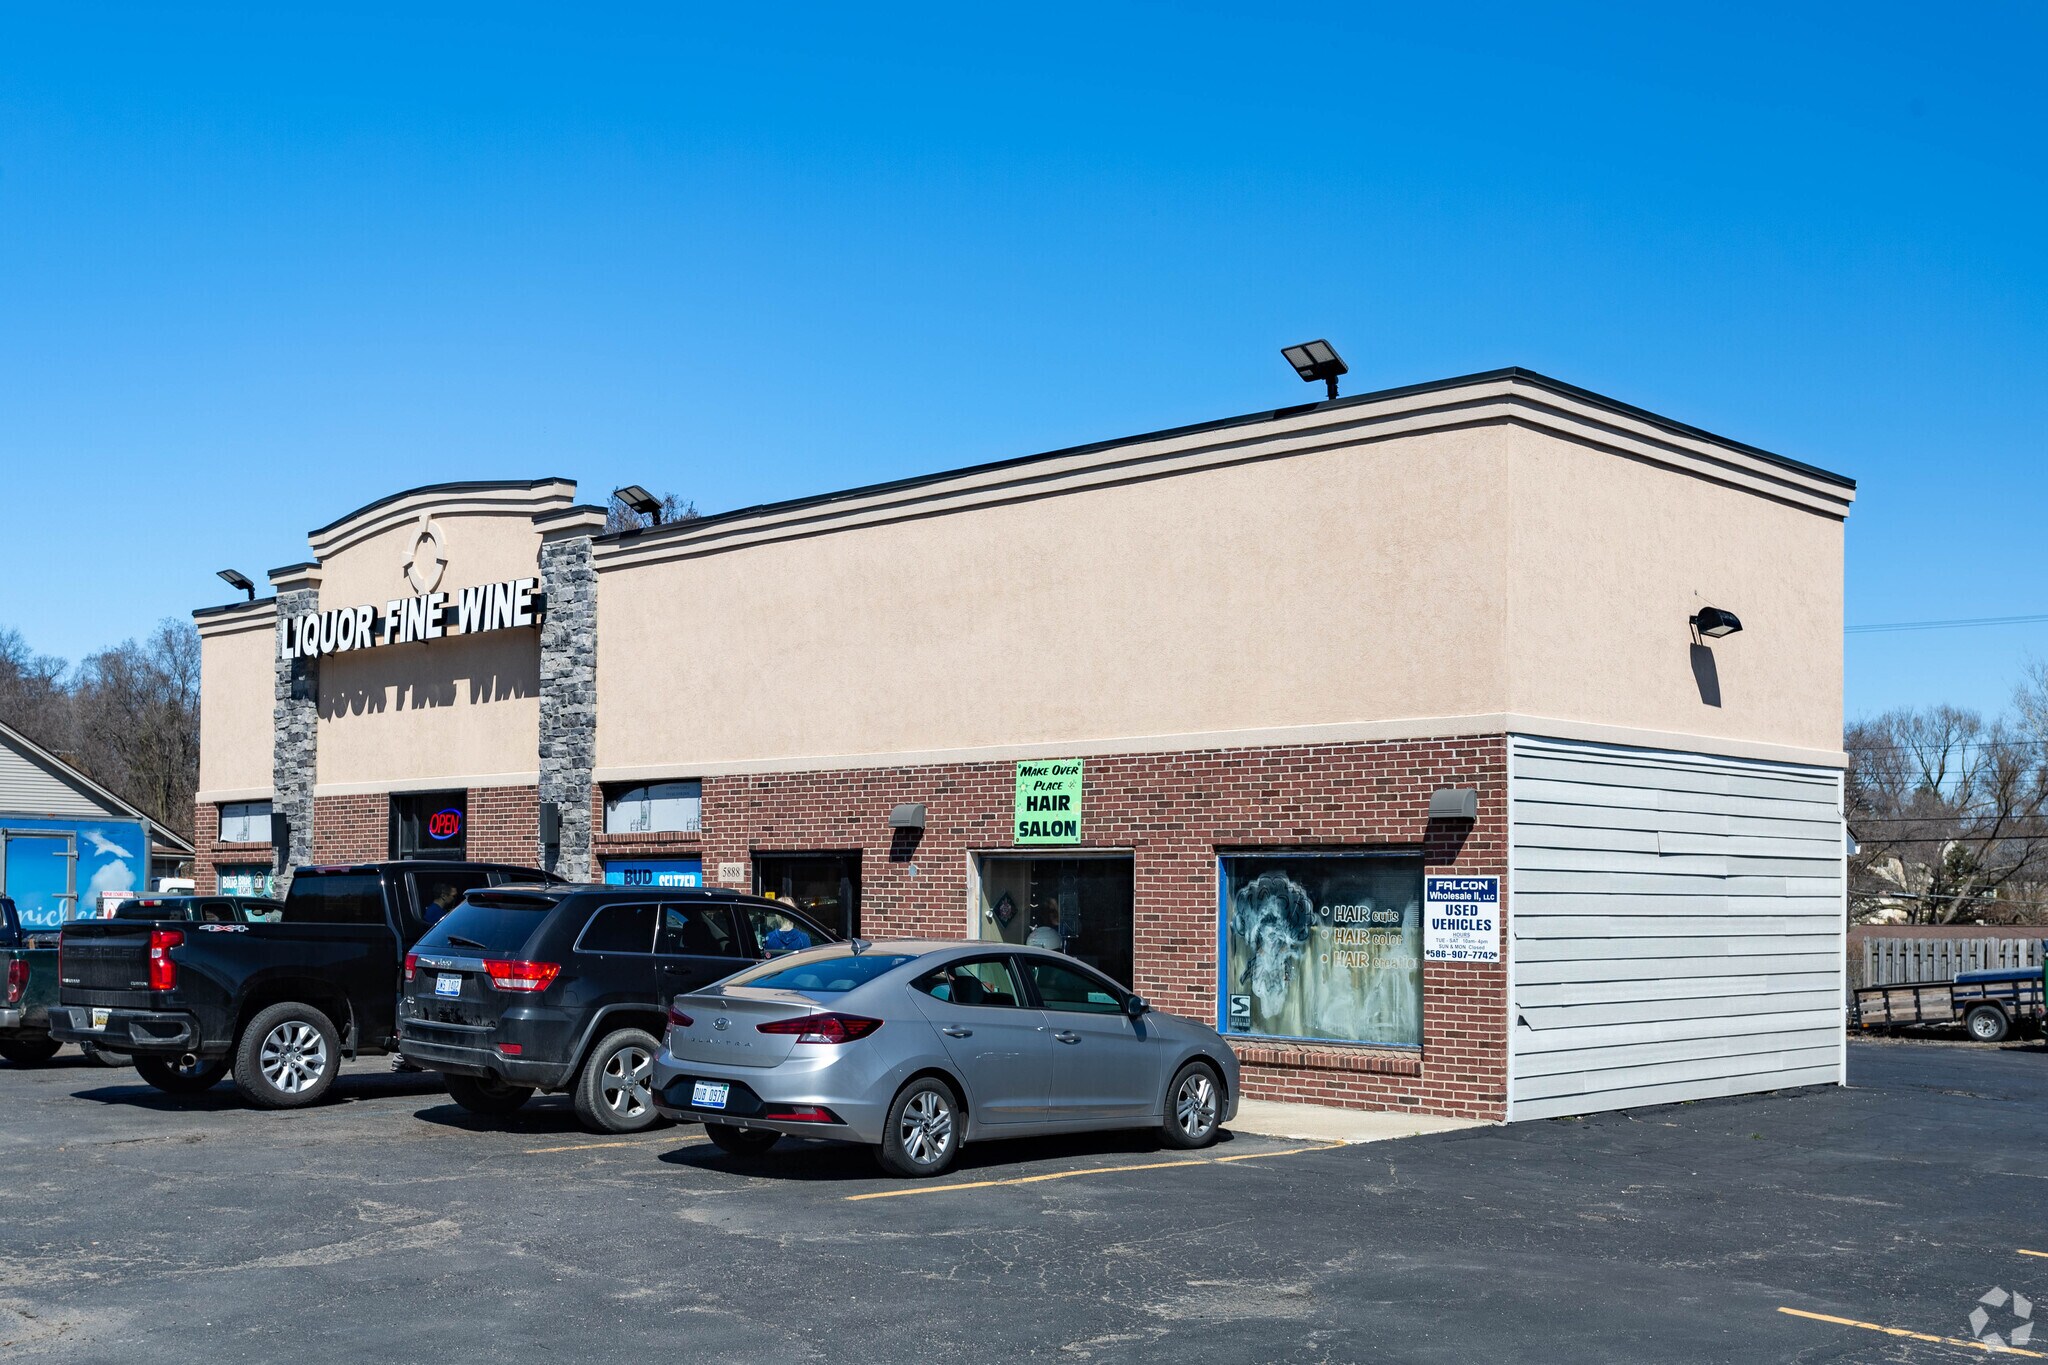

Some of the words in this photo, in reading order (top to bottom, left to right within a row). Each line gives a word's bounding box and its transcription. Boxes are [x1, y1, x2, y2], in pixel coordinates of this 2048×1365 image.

[281, 604, 376, 660] LIQUOR
[384, 592, 447, 645] FINE
[458, 577, 537, 635] WINE
[1026, 795, 1070, 811] HAIR
[429, 813, 460, 834] OPEN
[1019, 820, 1076, 837] SALON
[624, 869, 653, 885] BUD
[722, 866, 741, 878] 5888
[1436, 880, 1488, 890] FALCON
[1429, 891, 1472, 900] Wholesale
[1334, 905, 1370, 922] HAIR
[1371, 909, 1399, 923] cuts
[1445, 904, 1478, 916] USED
[1432, 918, 1492, 931] VEHICLES
[1334, 927, 1370, 945] HAIR
[1372, 932, 1404, 945] color
[1334, 950, 1370, 968] HAIR
[1429, 950, 1494, 960] 586-907-7742
